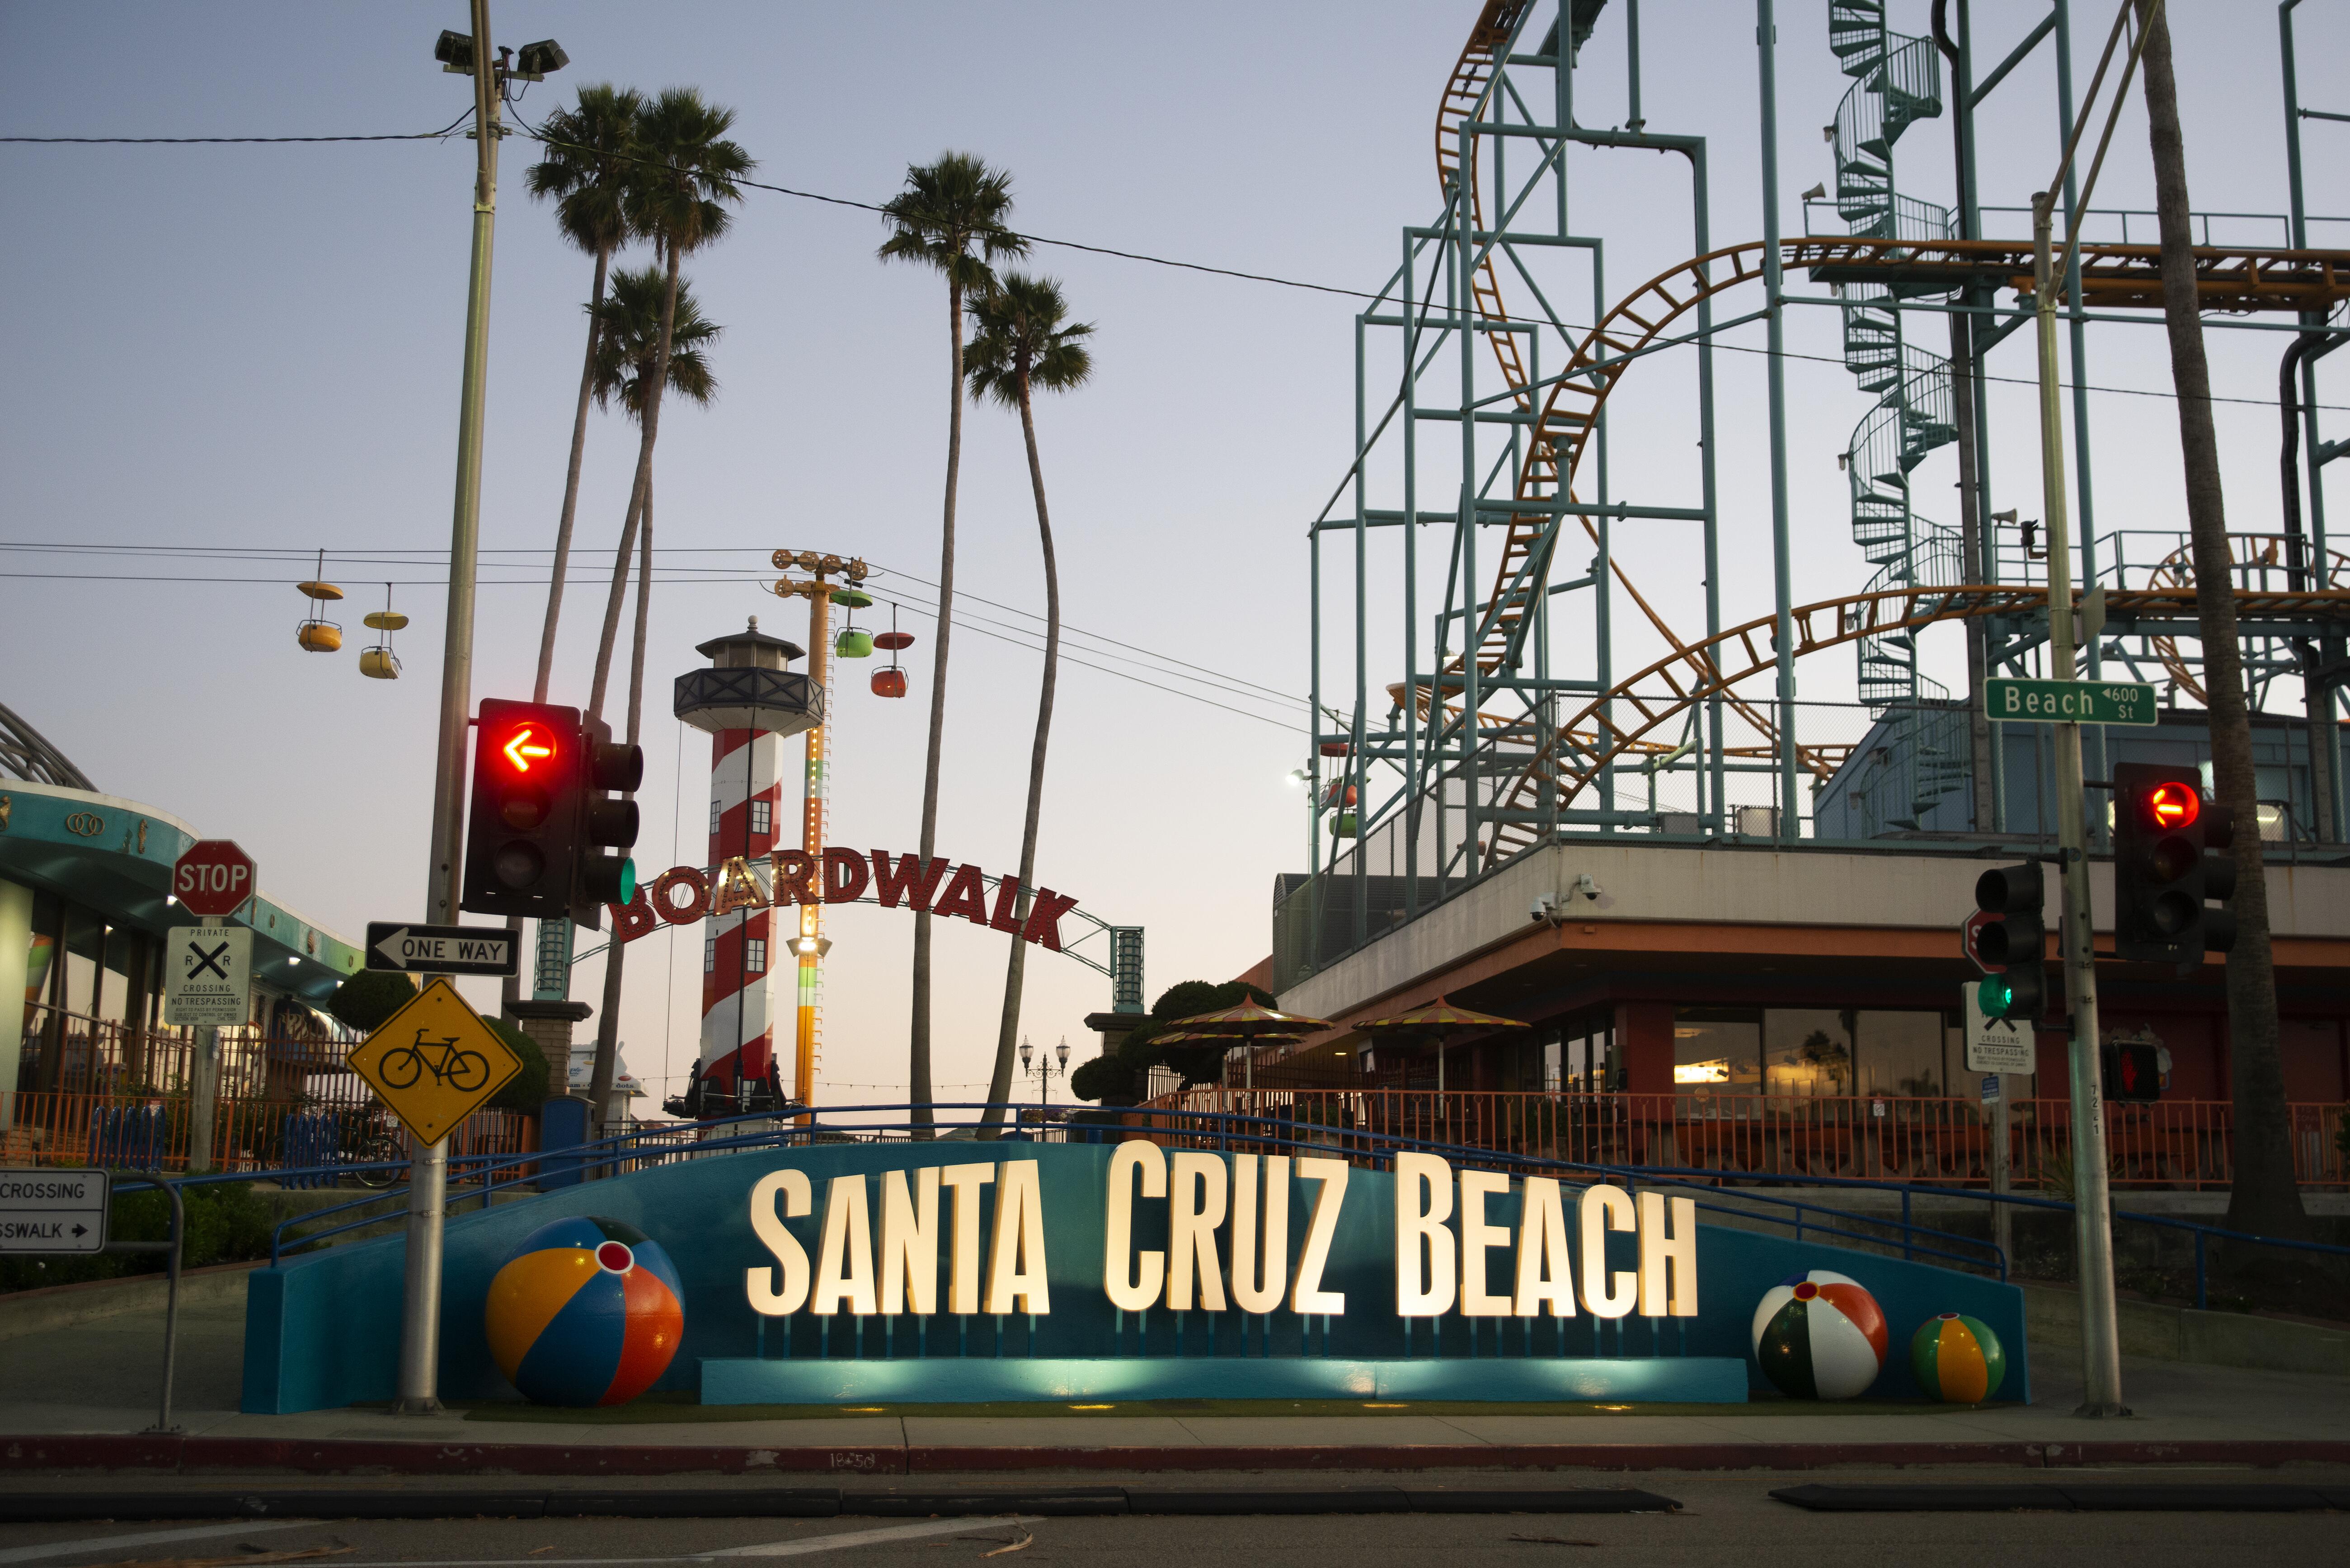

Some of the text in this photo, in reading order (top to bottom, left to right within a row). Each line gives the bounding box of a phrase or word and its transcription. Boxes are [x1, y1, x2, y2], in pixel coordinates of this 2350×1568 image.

[2005, 686, 2093, 714] Beach
[2112, 688, 2138, 703] 600
[2119, 704, 2133, 719] St
[179, 864, 248, 892] STOP
[608, 847, 1079, 952] BOARDWALK
[402, 939, 503, 960] ONE WAY
[185, 955, 230, 966] R R
[1981, 1035, 2020, 1044] CROSSING
[1984, 1047, 2029, 1056] TRESPASSING
[0, 1183, 85, 1198] CROSSING
[746, 1140, 1698, 1318] SANTA CRUZ BEACH
